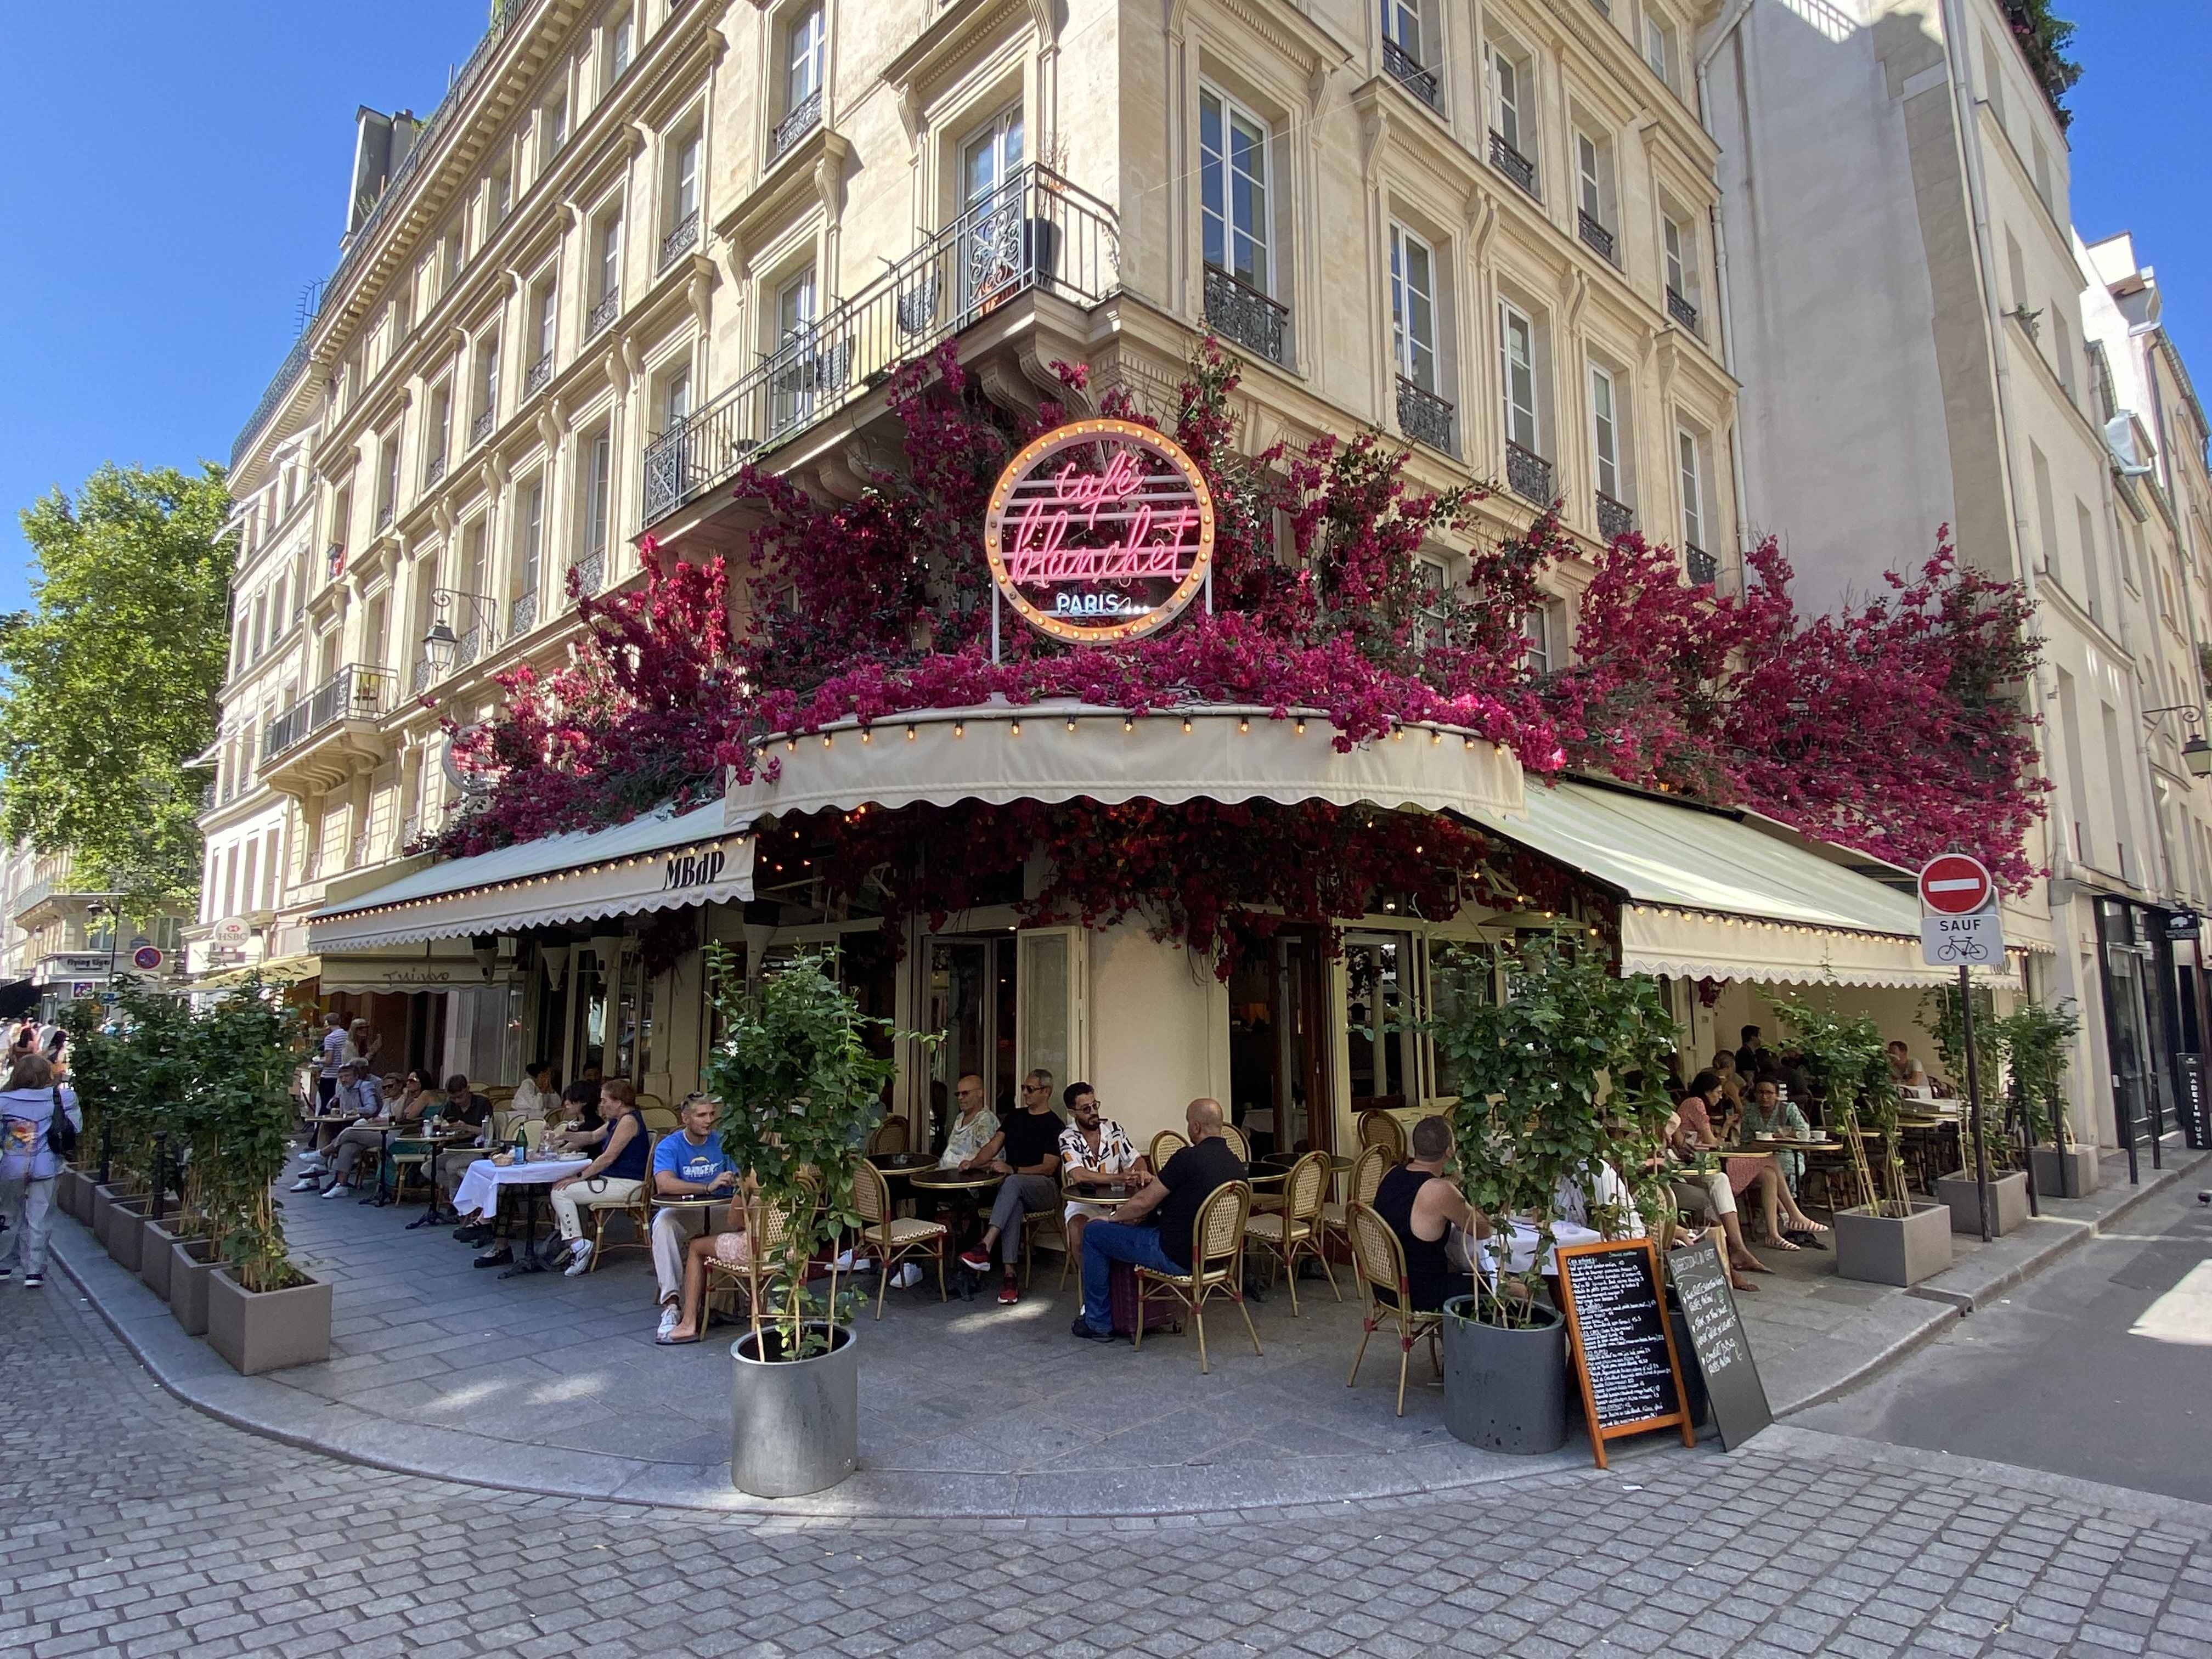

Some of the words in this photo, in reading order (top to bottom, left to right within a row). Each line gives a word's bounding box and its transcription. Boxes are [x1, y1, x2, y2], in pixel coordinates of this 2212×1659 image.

[1055, 451, 1144, 530] Café
[663, 851, 725, 890] MBdP
[219, 933, 247, 941] HSBC
[1940, 919, 1981, 931] SAUF
